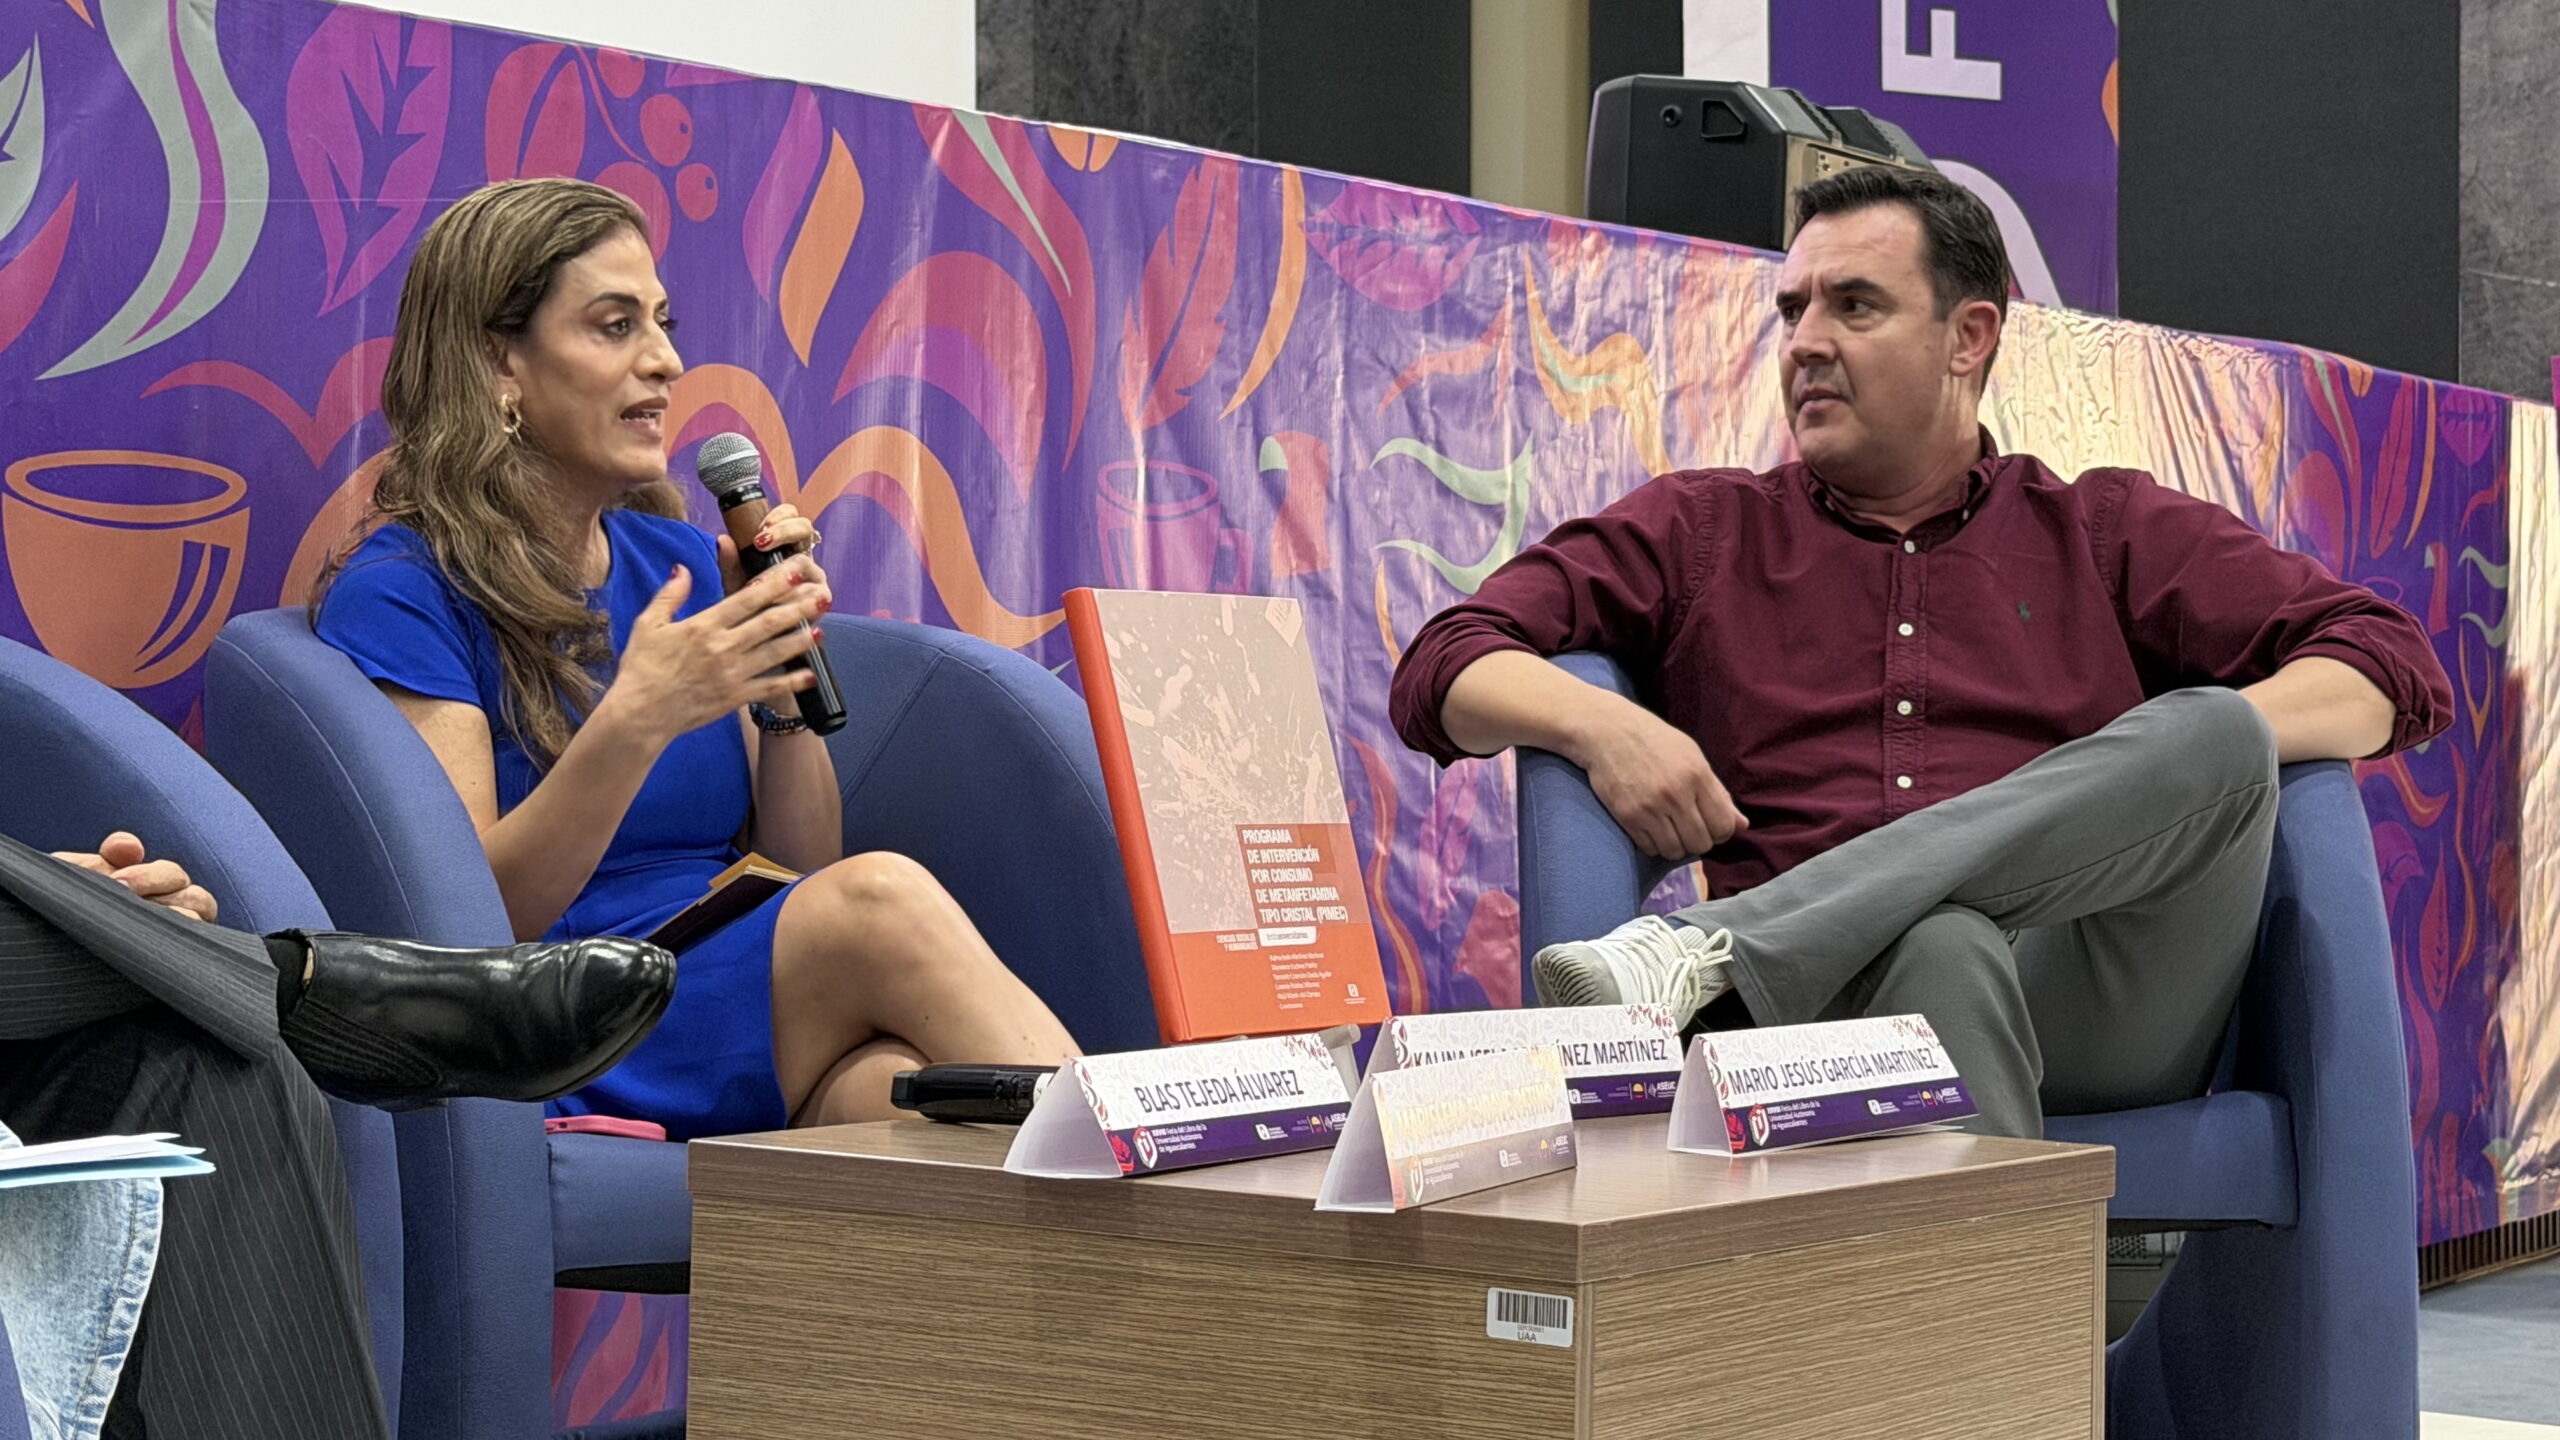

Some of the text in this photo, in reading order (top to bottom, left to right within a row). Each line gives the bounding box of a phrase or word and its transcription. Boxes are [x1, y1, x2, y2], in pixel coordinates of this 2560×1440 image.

[1242, 829, 1293, 844] PROGRAMA
[1246, 844, 1320, 864] DE INTERVENCIÓN
[1250, 867, 1313, 884] POR CONSUMO
[1255, 887, 1340, 903] DE METANFETAMINA
[1259, 905, 1349, 924] TIPO CRISTAL (PIMEC)
[1593, 1035, 1668, 1066] MARTÍNEZ
[1728, 1044, 1939, 1095] MARIO JESÚS GARCÍA MARTÍNEZ
[1134, 1067, 1304, 1113] BLAS TEJEDA ÁLVAREZ
[1517, 1331, 1537, 1342] UAA
